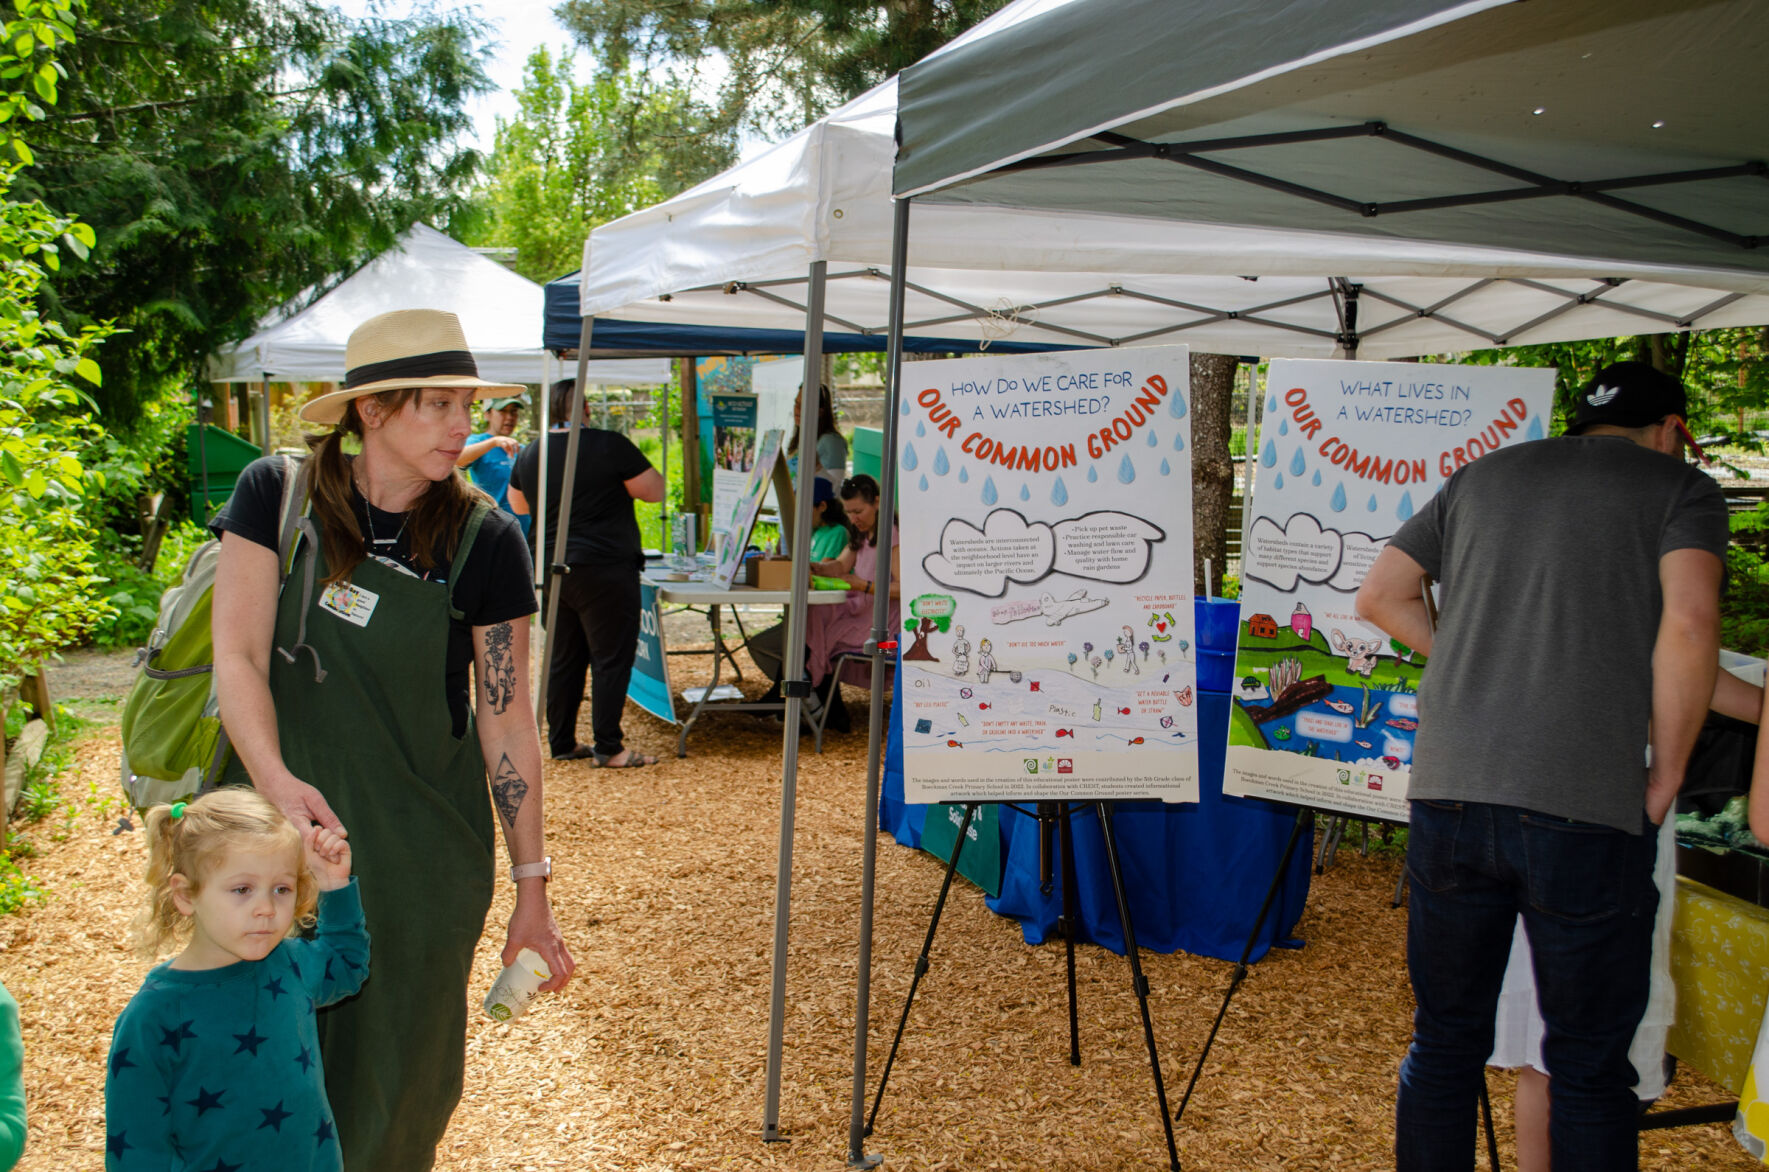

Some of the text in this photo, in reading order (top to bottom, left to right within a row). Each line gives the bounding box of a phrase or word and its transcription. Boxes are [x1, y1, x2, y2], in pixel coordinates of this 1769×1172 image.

[952, 371, 1132, 396] HOW DO WE CARE FOR
[1340, 380, 1470, 401] WHAT LIVES IN
[972, 396, 1110, 420] A WATERSHED?
[1337, 406, 1472, 427] A WATERSHED?
[918, 374, 1168, 473] OUR COMMON GROUND
[1285, 387, 1527, 485] OUR COMMON GROUND
